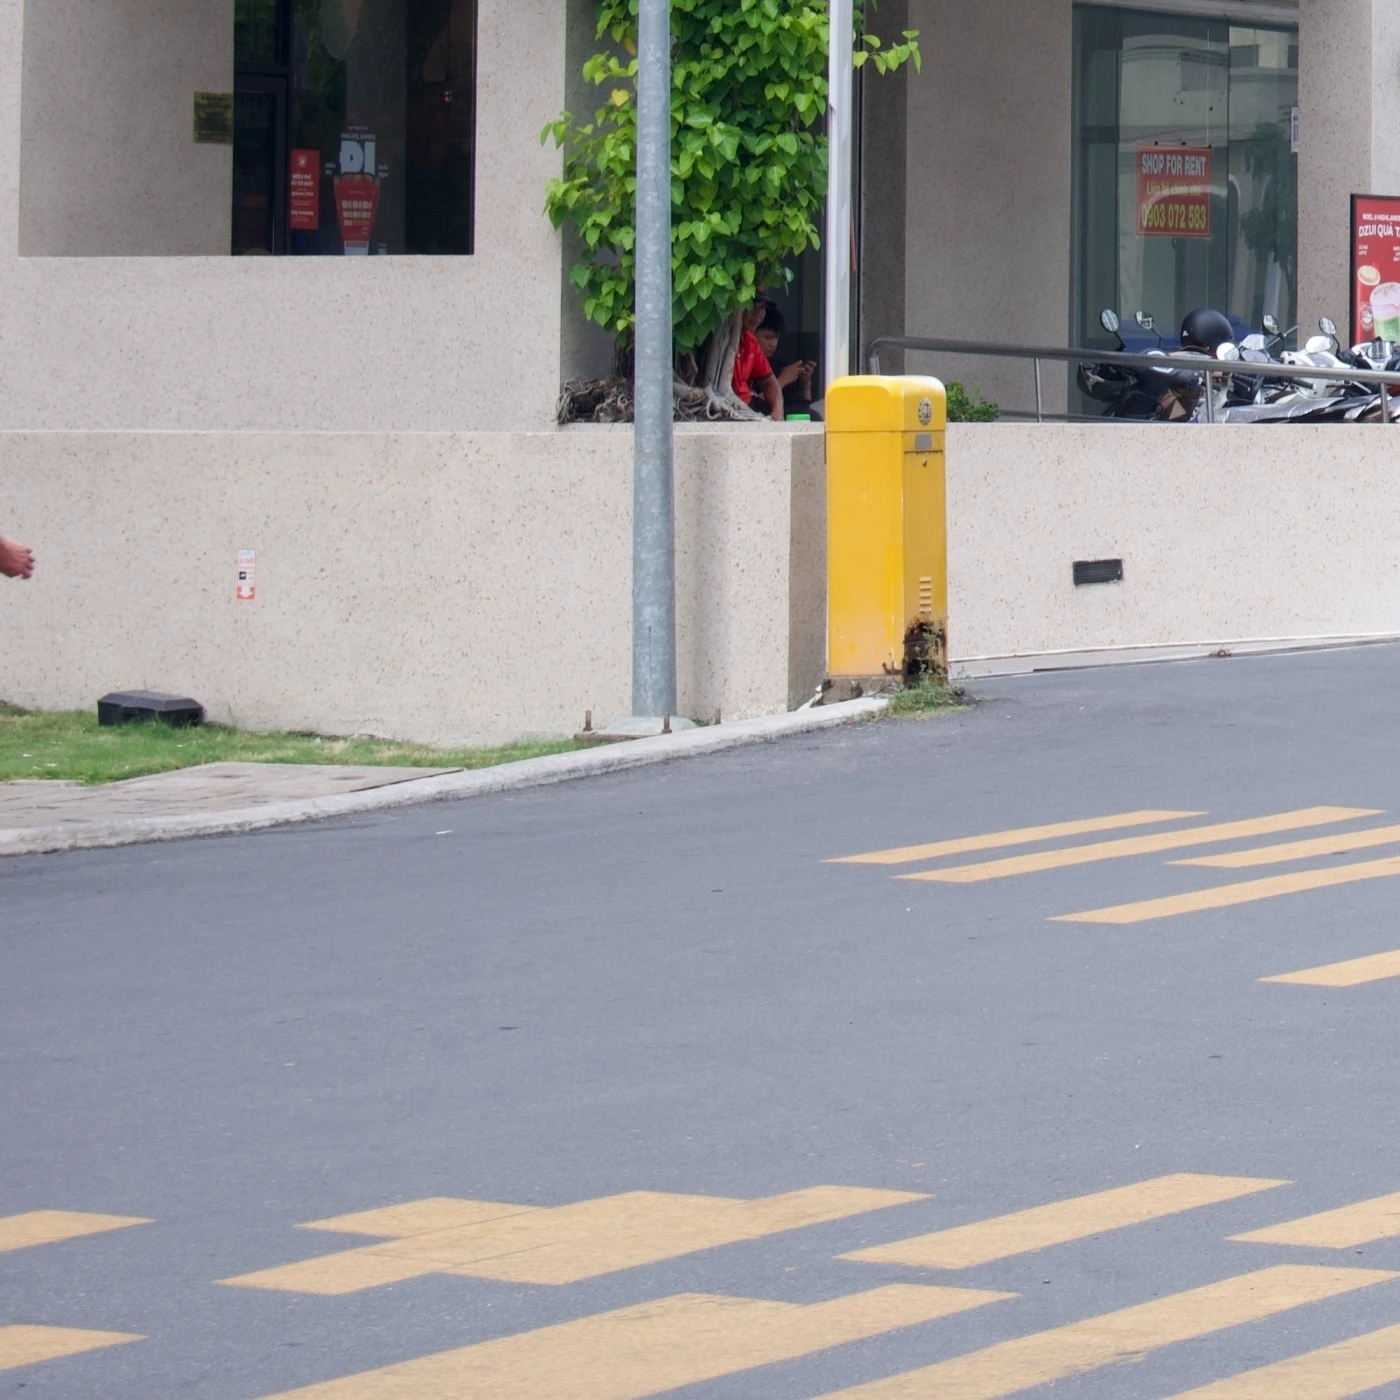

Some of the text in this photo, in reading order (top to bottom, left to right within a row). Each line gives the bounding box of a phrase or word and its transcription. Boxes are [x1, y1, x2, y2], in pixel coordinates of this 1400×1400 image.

[1142, 154, 1206, 176] SHOP FOR RENT
[1142, 204, 1206, 229] 0903 072 583
[1359, 225, 1376, 237] DZUI
[1377, 221, 1394, 238] QUÁ
